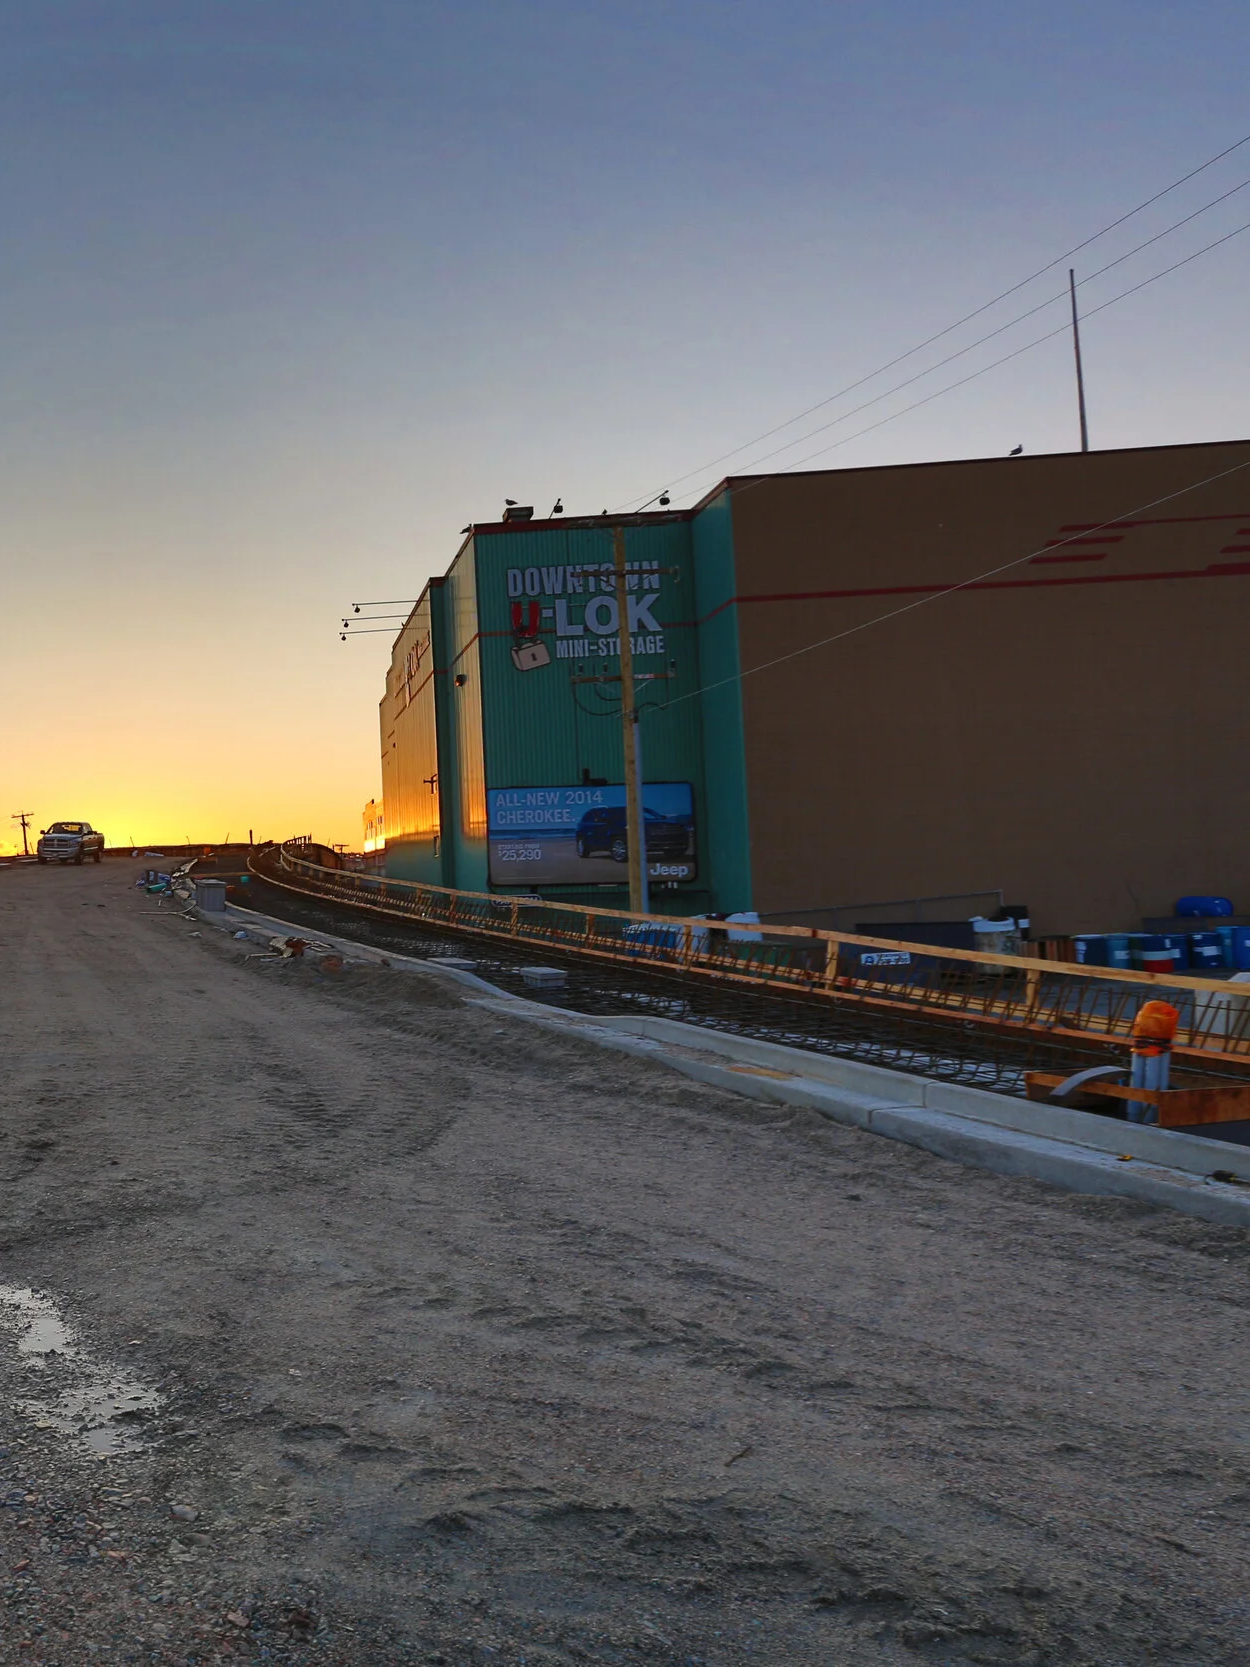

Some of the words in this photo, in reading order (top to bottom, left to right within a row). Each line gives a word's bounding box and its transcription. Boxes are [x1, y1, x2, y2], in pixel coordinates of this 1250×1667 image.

[510, 593, 663, 638] U-LOK
[496, 791, 560, 807] ALL-NEW
[565, 790, 603, 805] 2014
[496, 808, 576, 824] CHEROKEE.
[649, 863, 689, 878] Jeep
